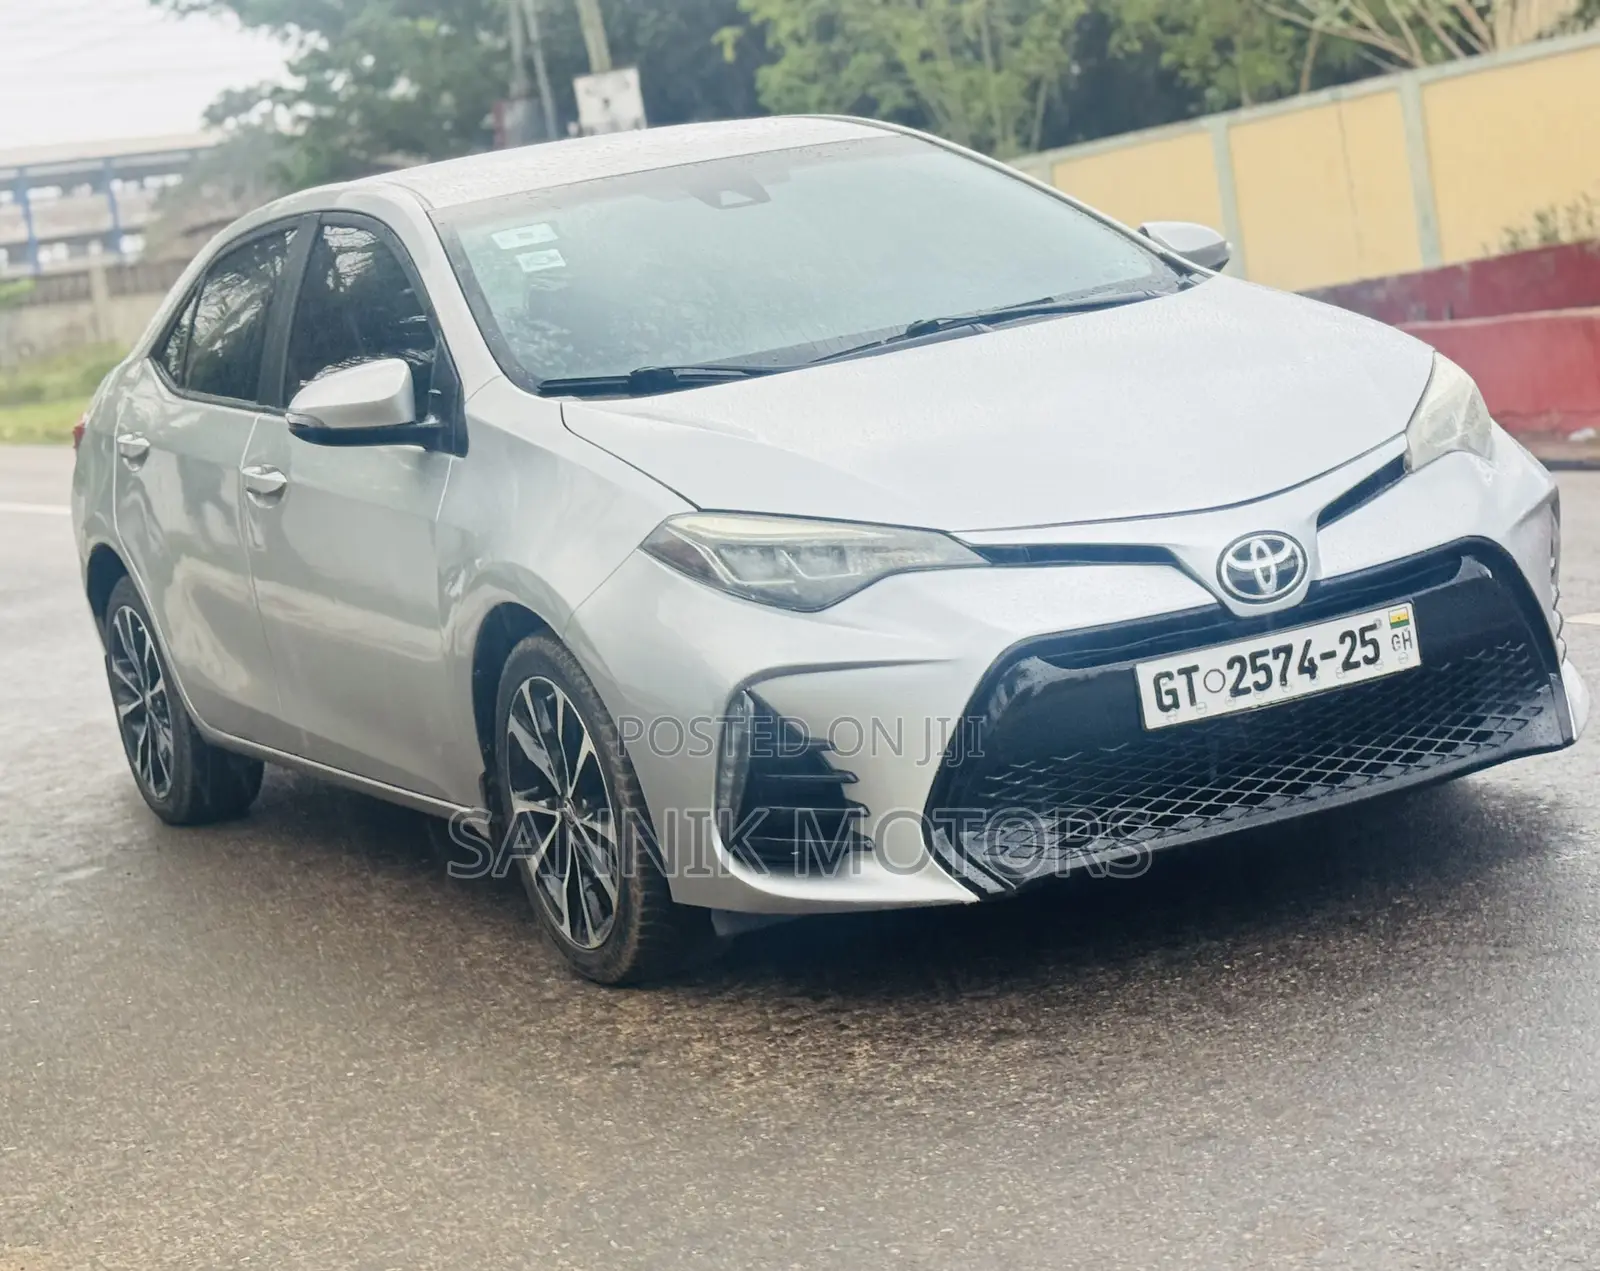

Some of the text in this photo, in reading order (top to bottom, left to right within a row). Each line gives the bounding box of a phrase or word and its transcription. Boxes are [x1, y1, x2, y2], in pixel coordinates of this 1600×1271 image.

[1152, 623, 1381, 713] GT 2574-25
[1391, 630, 1413, 652] GH
